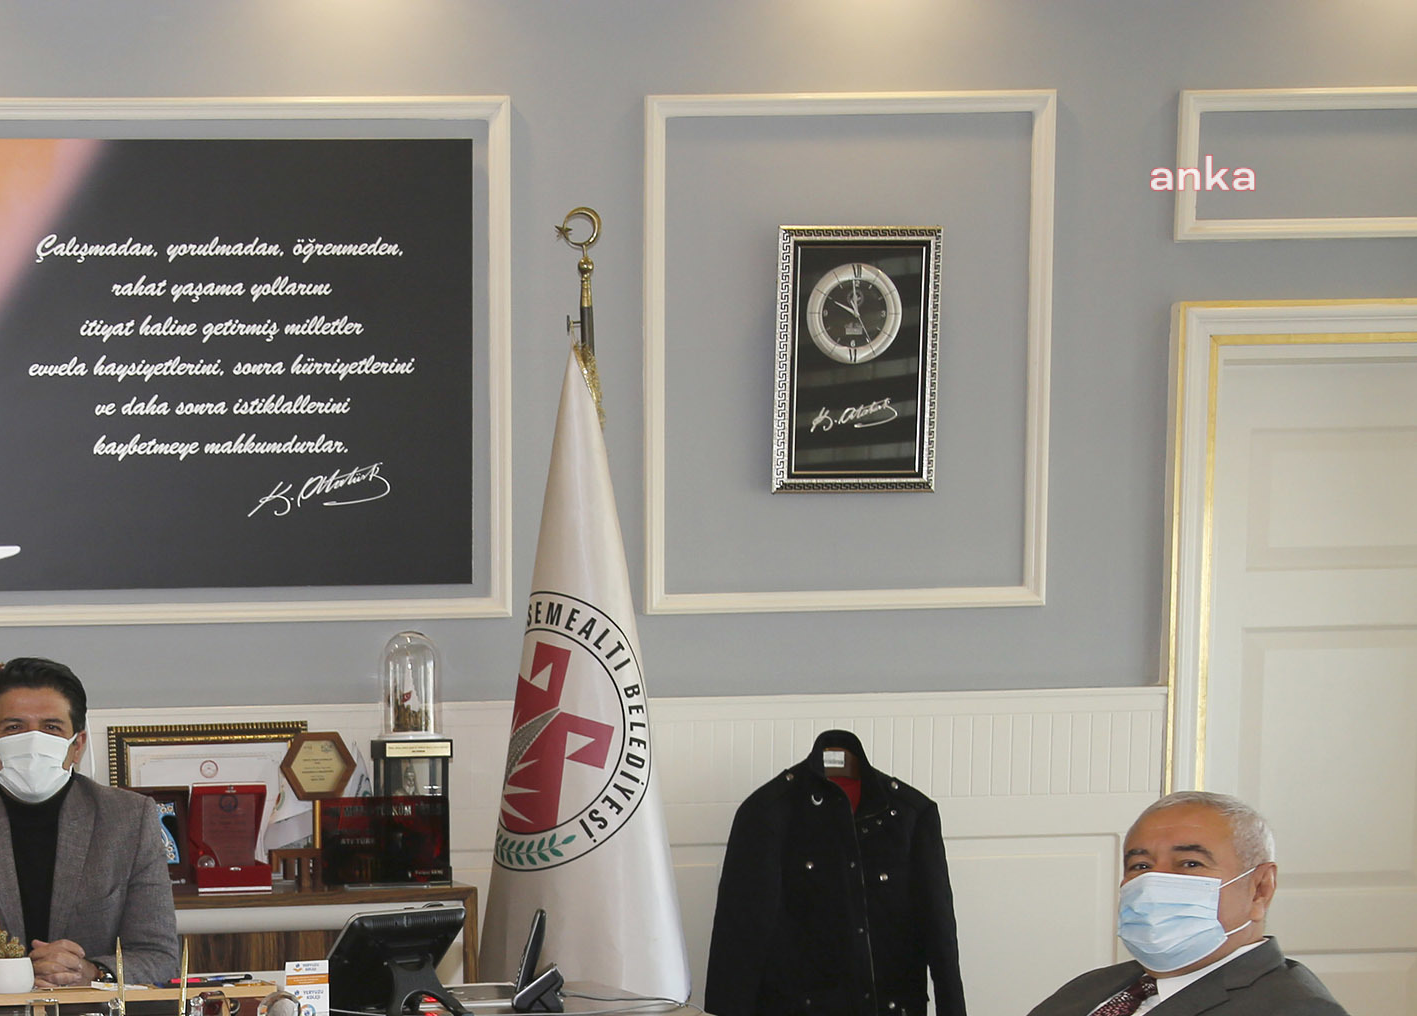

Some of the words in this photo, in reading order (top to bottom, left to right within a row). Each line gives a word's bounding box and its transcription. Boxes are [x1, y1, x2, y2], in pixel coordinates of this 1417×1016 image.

[35, 233, 158, 264] Çalışmadan,
[166, 236, 284, 263] yorulmadan,
[292, 236, 404, 264] öğrenmeden,
[110, 274, 167, 297] rahat
[170, 282, 246, 303] yaşama
[250, 275, 333, 303] yollarını
[79, 319, 135, 343] itiyat
[138, 314, 198, 337] haline
[202, 318, 280, 344] getirmiş
[284, 315, 365, 336] milletler
[28, 356, 89, 377] evvela
[93, 354, 225, 383] haysiyetlerini,
[232, 361, 286, 376] sonra
[290, 353, 416, 381] hürriyetlerini
[94, 402, 117, 416] ve
[121, 394, 171, 416] daha
[174, 401, 229, 416] sonra
[232, 393, 351, 415] istiklallerini
[92, 433, 200, 461] kaybetmeye
[203, 432, 349, 455] mahkumdurlar.
[579, 683, 647, 844] BELEDİYESİ
